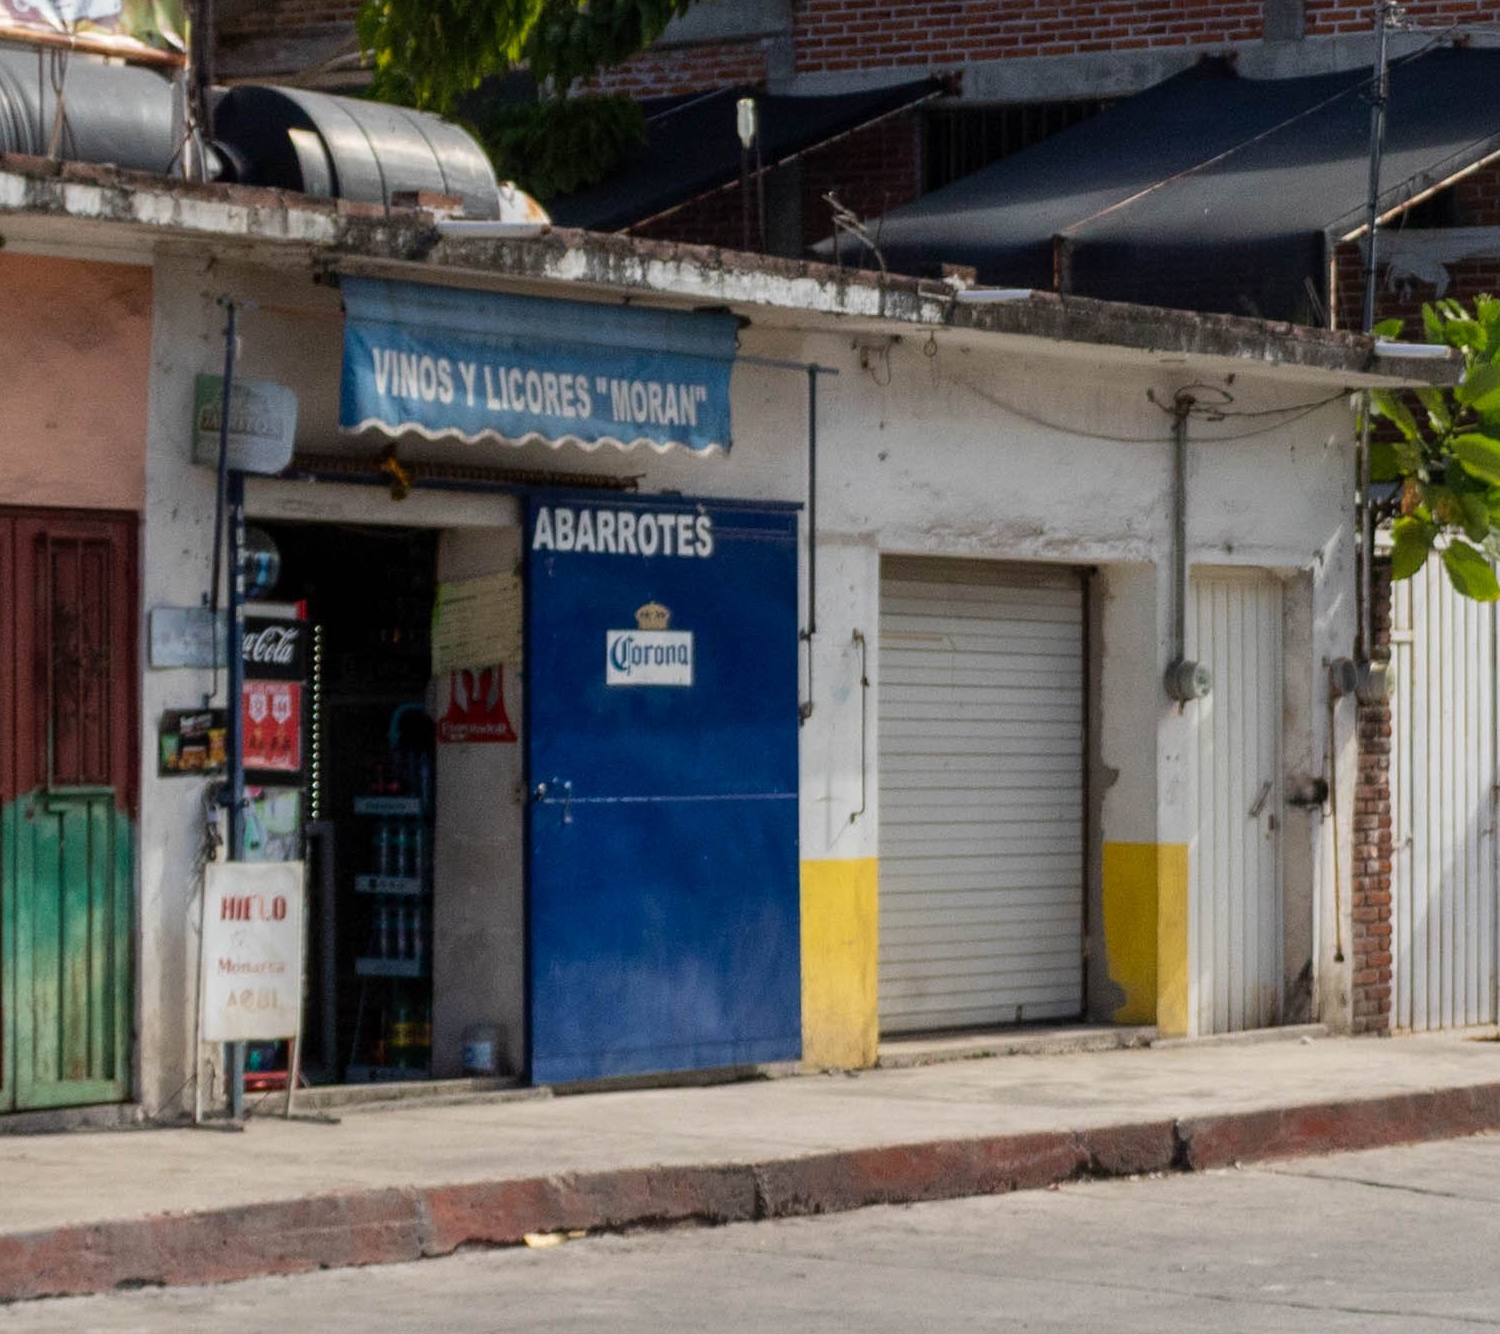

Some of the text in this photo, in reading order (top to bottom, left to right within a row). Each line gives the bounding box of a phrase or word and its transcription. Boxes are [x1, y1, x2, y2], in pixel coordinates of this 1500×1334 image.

[372, 347, 707, 427] VINOS Y LICORES "MORAN"
[531, 506, 715, 558] ABARROTES
[610, 634, 689, 676] Corona
[219, 893, 288, 923] HIELO
